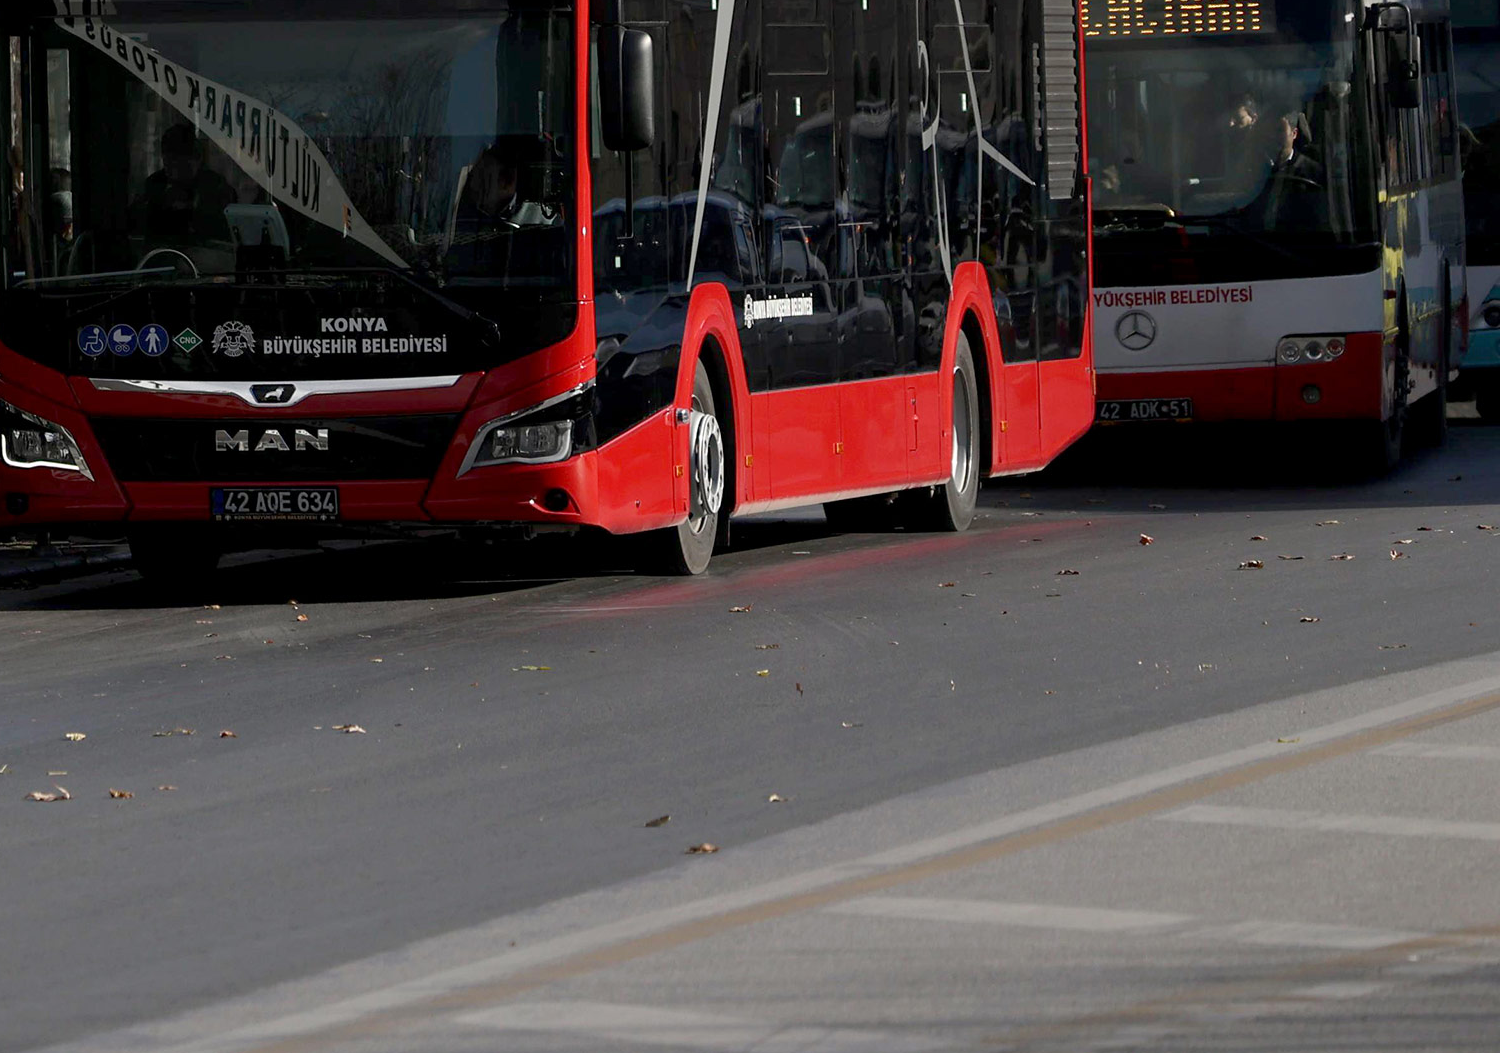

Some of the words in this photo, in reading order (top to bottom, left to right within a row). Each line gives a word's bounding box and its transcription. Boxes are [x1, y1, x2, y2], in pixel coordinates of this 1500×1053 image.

[1170, 286, 1253, 305] BELEDİYESİ
[320, 317, 389, 333] KONYA
[179, 336, 197, 345] CNG
[262, 337, 358, 359] BÜYÜKŞEHİR
[361, 334, 448, 354] BELEDİYESİ
[1100, 403, 1121, 420] 42
[215, 428, 329, 452] MAN
[224, 491, 250, 513] 42
[297, 491, 335, 512] 634
